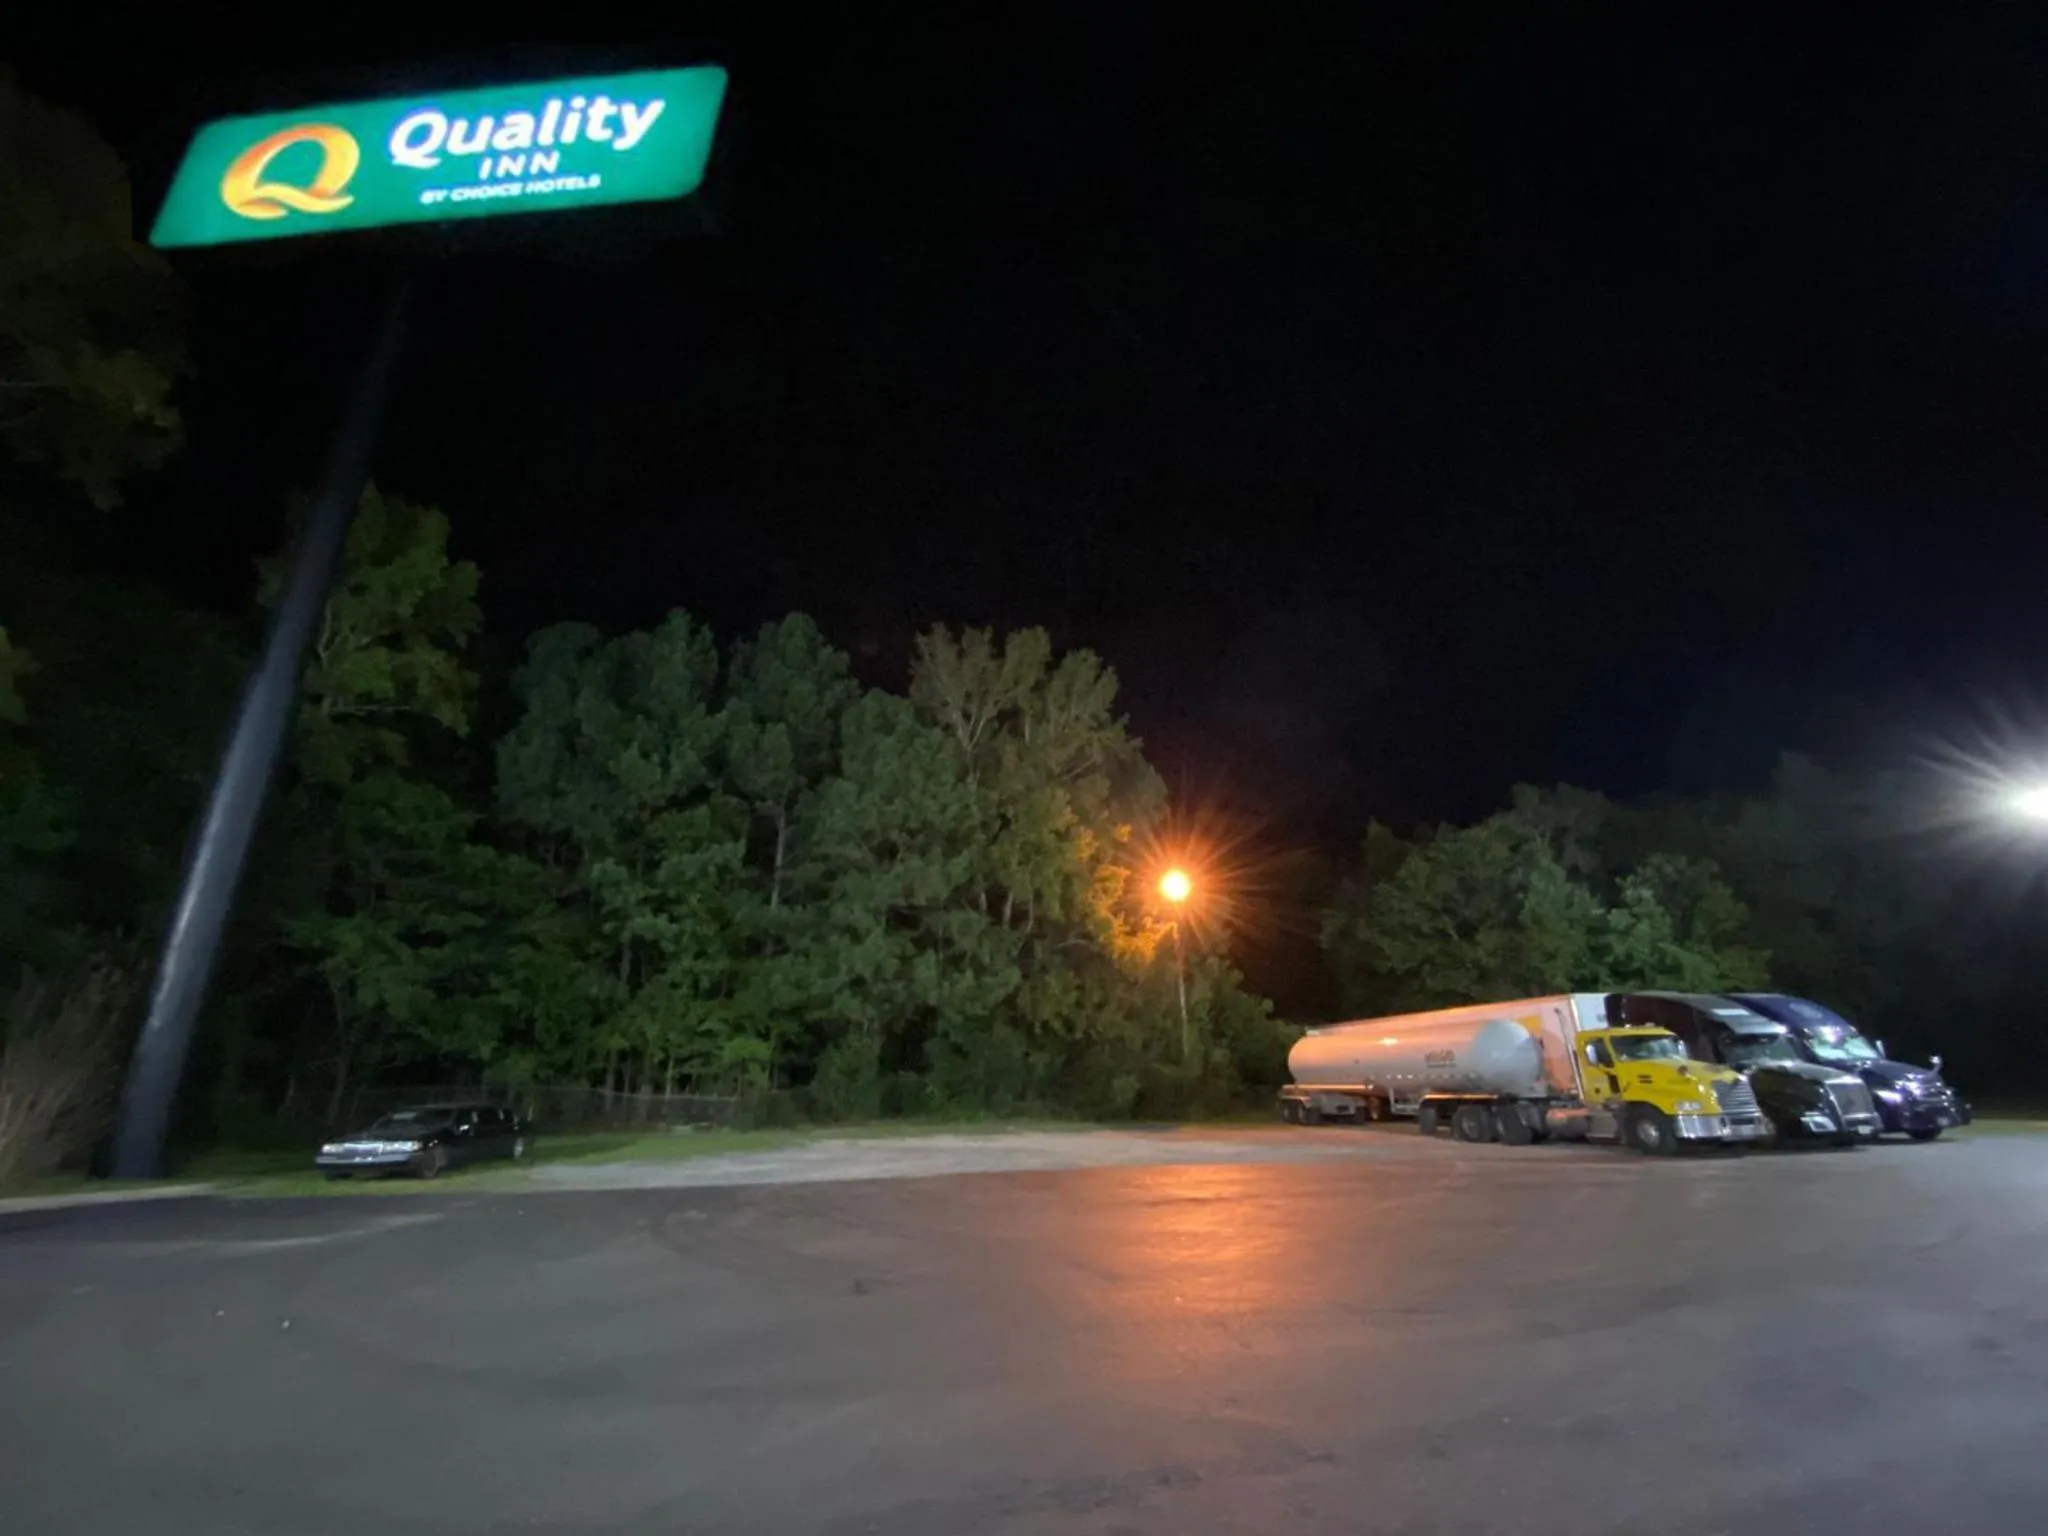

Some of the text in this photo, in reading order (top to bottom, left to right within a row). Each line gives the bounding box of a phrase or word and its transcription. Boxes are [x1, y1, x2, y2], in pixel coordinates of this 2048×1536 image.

[388, 95, 665, 168] Quality
[221, 122, 360, 220] Q
[420, 174, 601, 204] BY CHOICE HOTELS
[478, 150, 560, 180] INN
